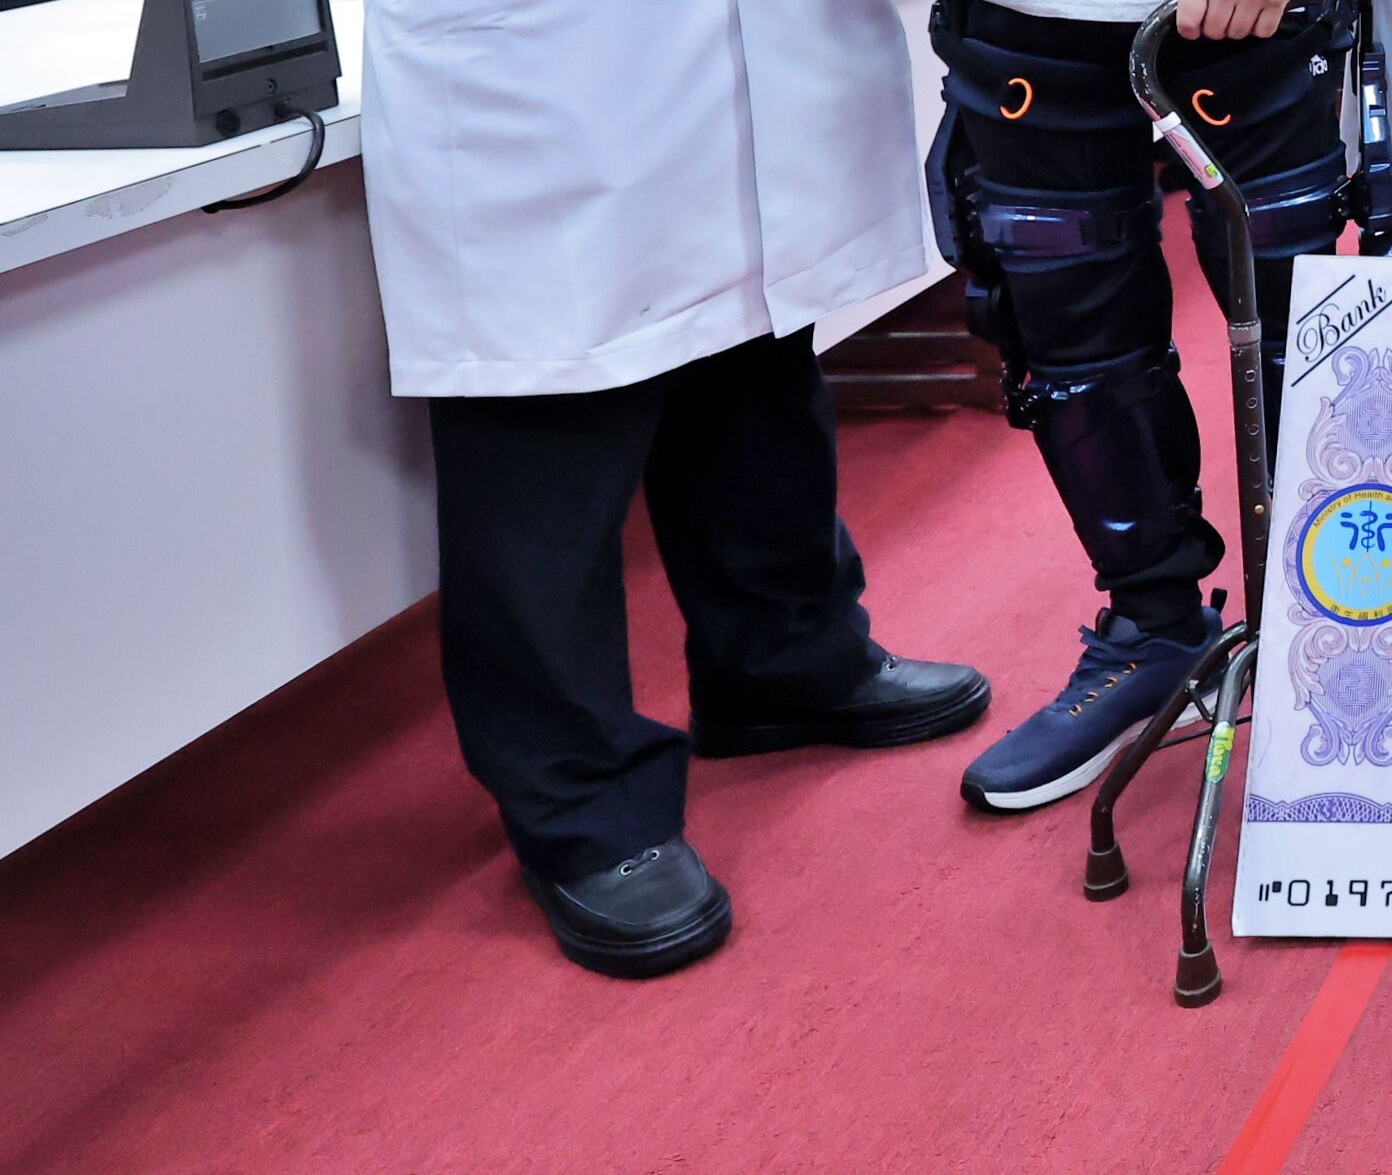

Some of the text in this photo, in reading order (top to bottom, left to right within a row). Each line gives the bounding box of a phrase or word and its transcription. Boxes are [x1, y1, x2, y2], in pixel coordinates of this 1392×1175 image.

[1296, 278, 1387, 364] Bank
[1313, 500, 1342, 528] Ministry
[1343, 494, 1353, 504] of
[1354, 490, 1384, 500] Health
